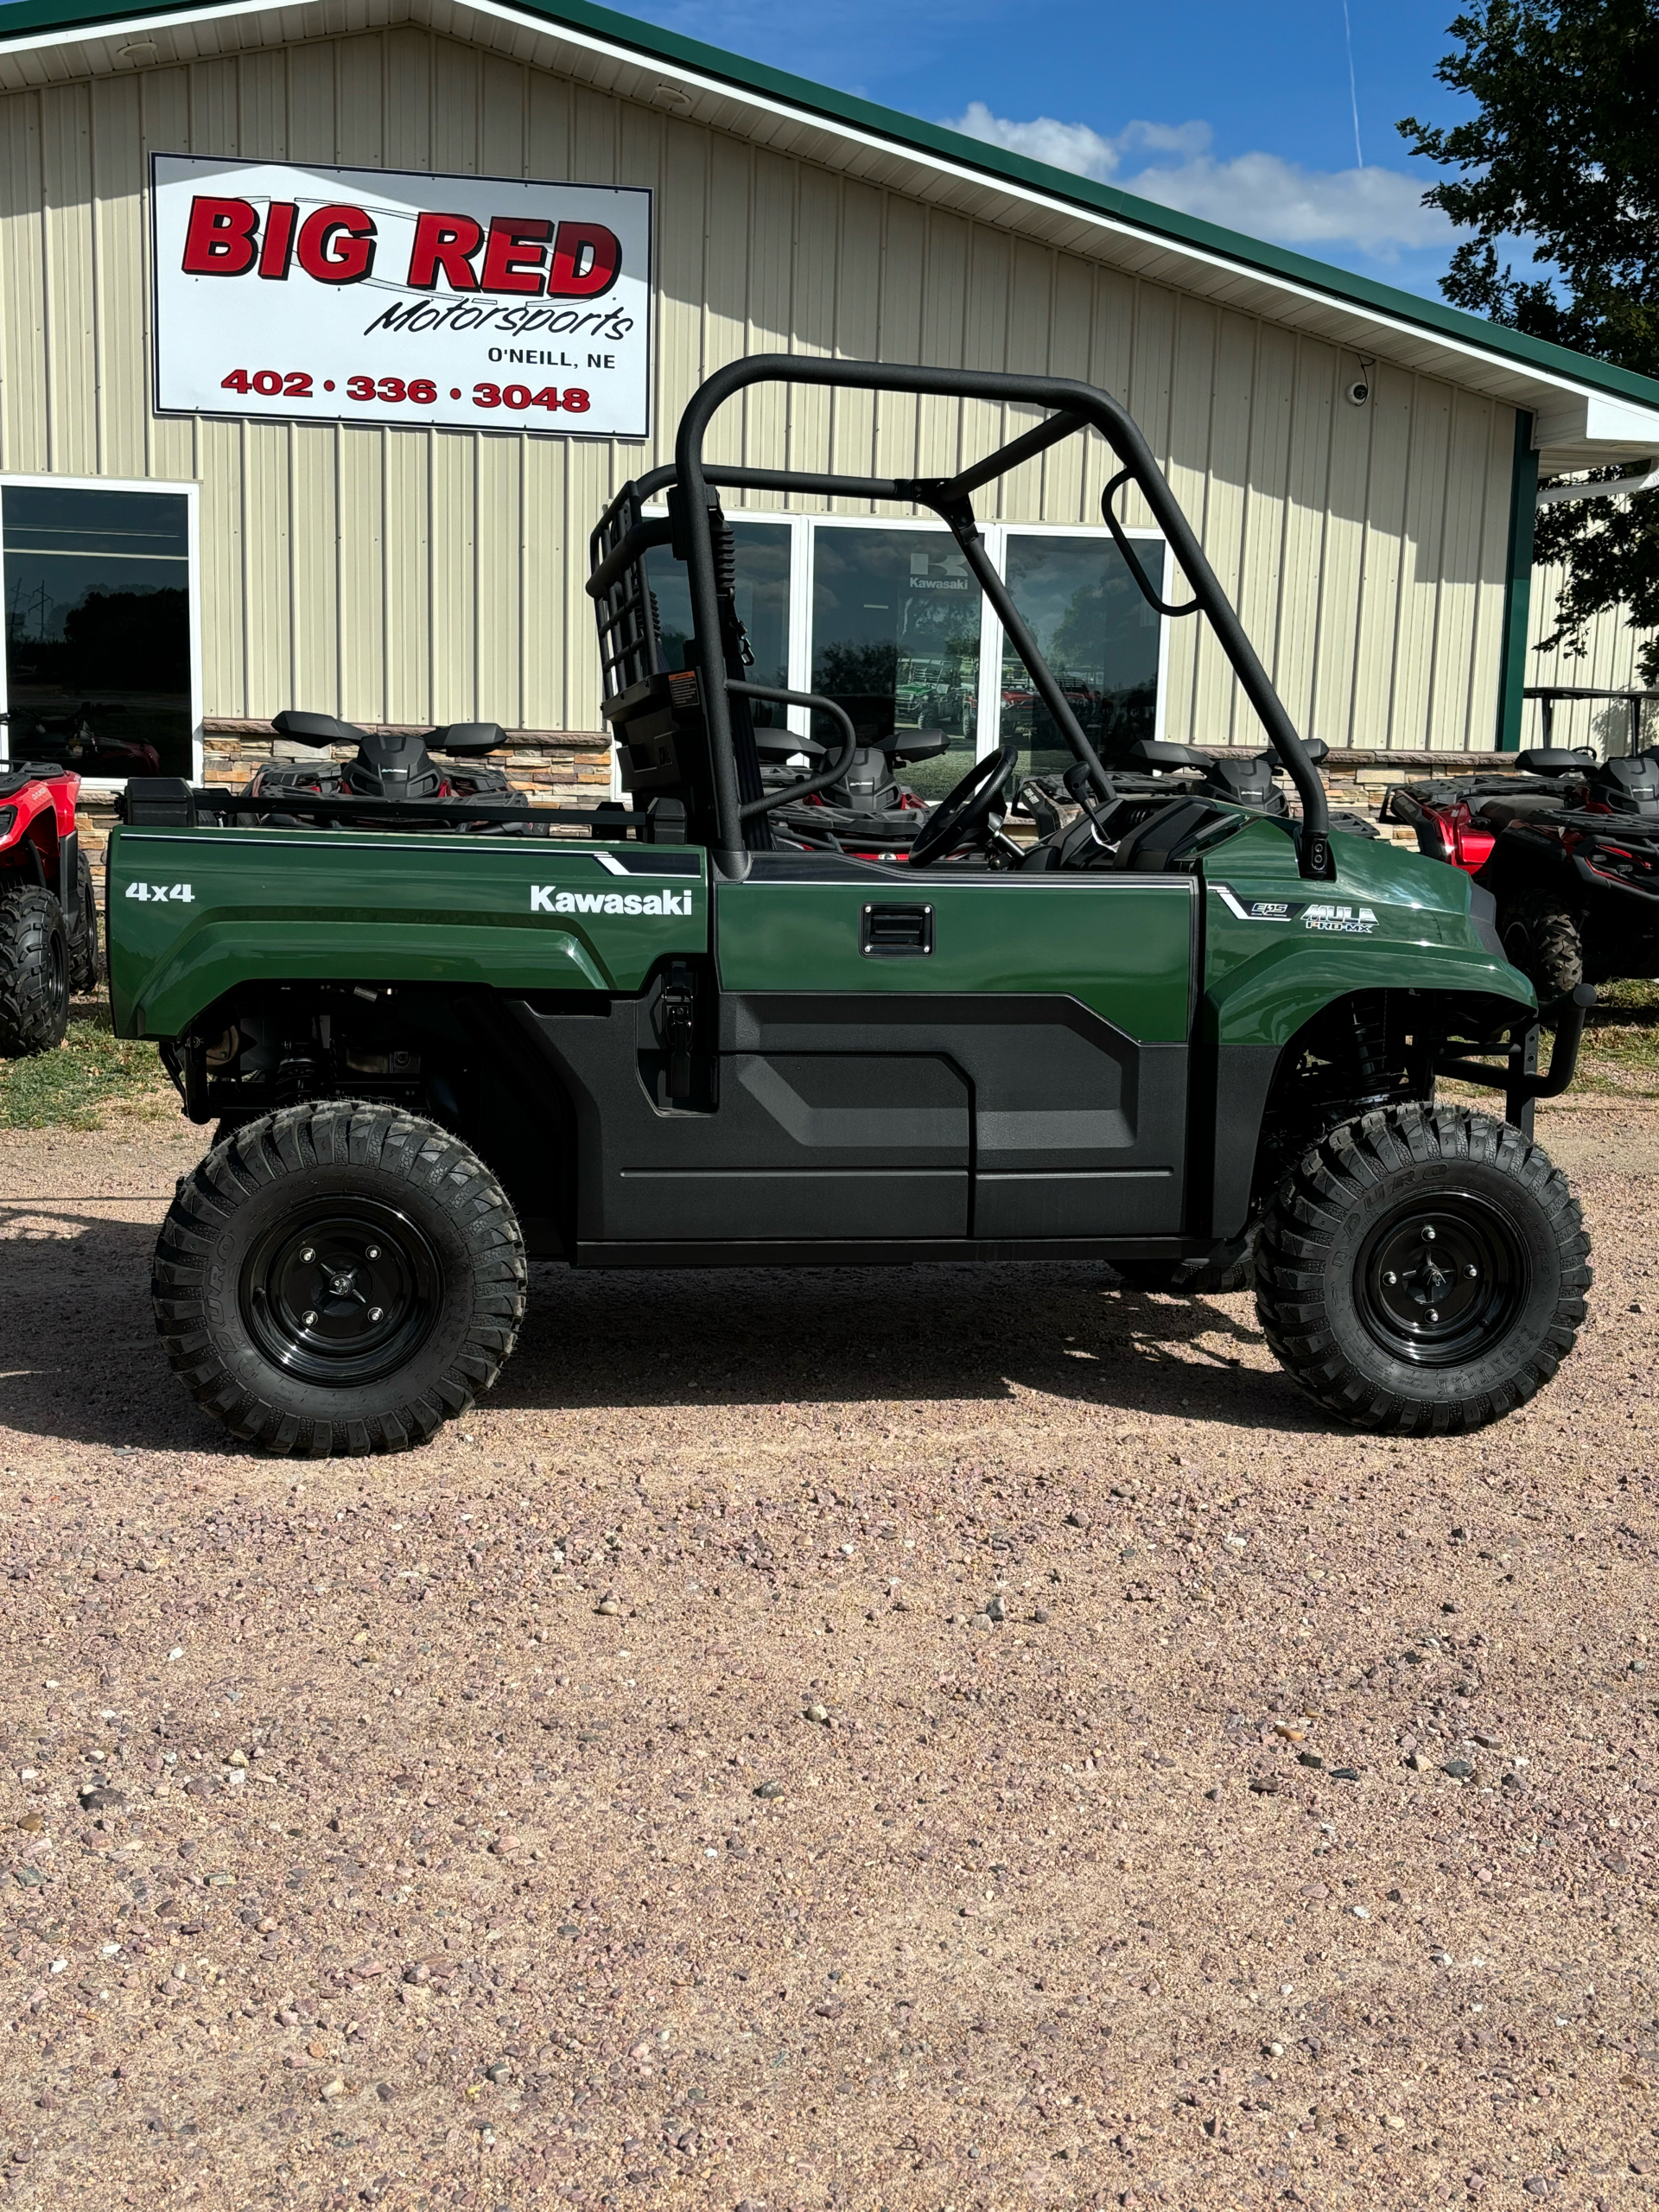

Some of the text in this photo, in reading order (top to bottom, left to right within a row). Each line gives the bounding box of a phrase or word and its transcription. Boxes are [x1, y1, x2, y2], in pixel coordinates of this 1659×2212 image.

[181, 194, 623, 299] BIG RED
[364, 300, 634, 340] Motorsports
[487, 346, 616, 370] O'NEILL, NE
[220, 369, 591, 413] 402 336 3048
[909, 576, 969, 590] Kawasaki
[125, 881, 195, 903] 4x4
[530, 885, 692, 916] Kawasaki
[1300, 904, 1379, 925] MULE
[1306, 921, 1373, 933] PRO-MX
[1343, 1162, 1449, 1242] DURO
[207, 1232, 238, 1353] DURO
[1434, 1324, 1541, 1395] FRONTIER
